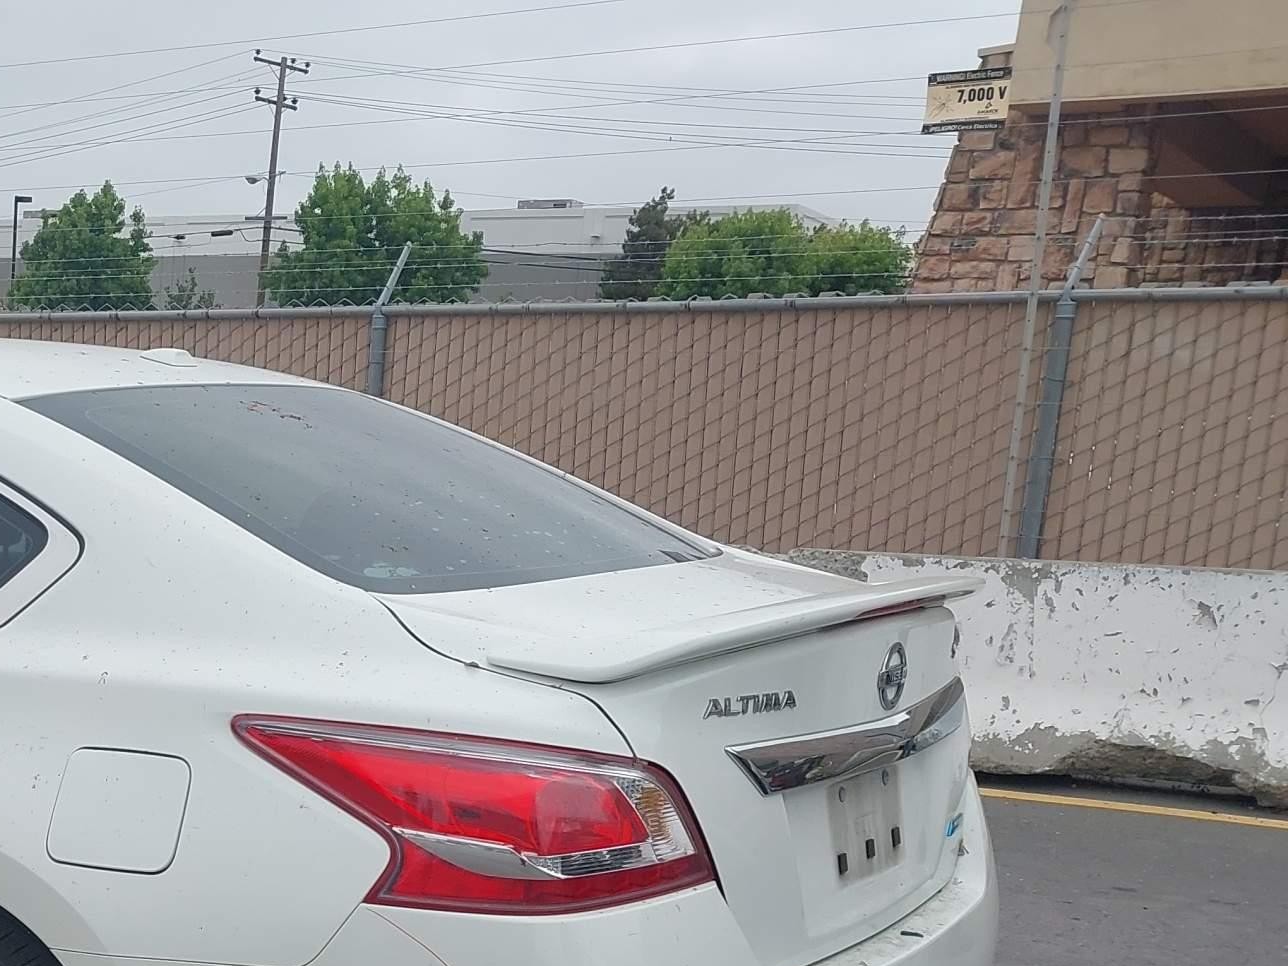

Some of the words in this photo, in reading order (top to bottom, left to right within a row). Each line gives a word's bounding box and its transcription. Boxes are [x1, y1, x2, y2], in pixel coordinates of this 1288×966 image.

[957, 86, 994, 104] 7,000
[998, 86, 1008, 100] V
[703, 690, 797, 720] ALTIMA
